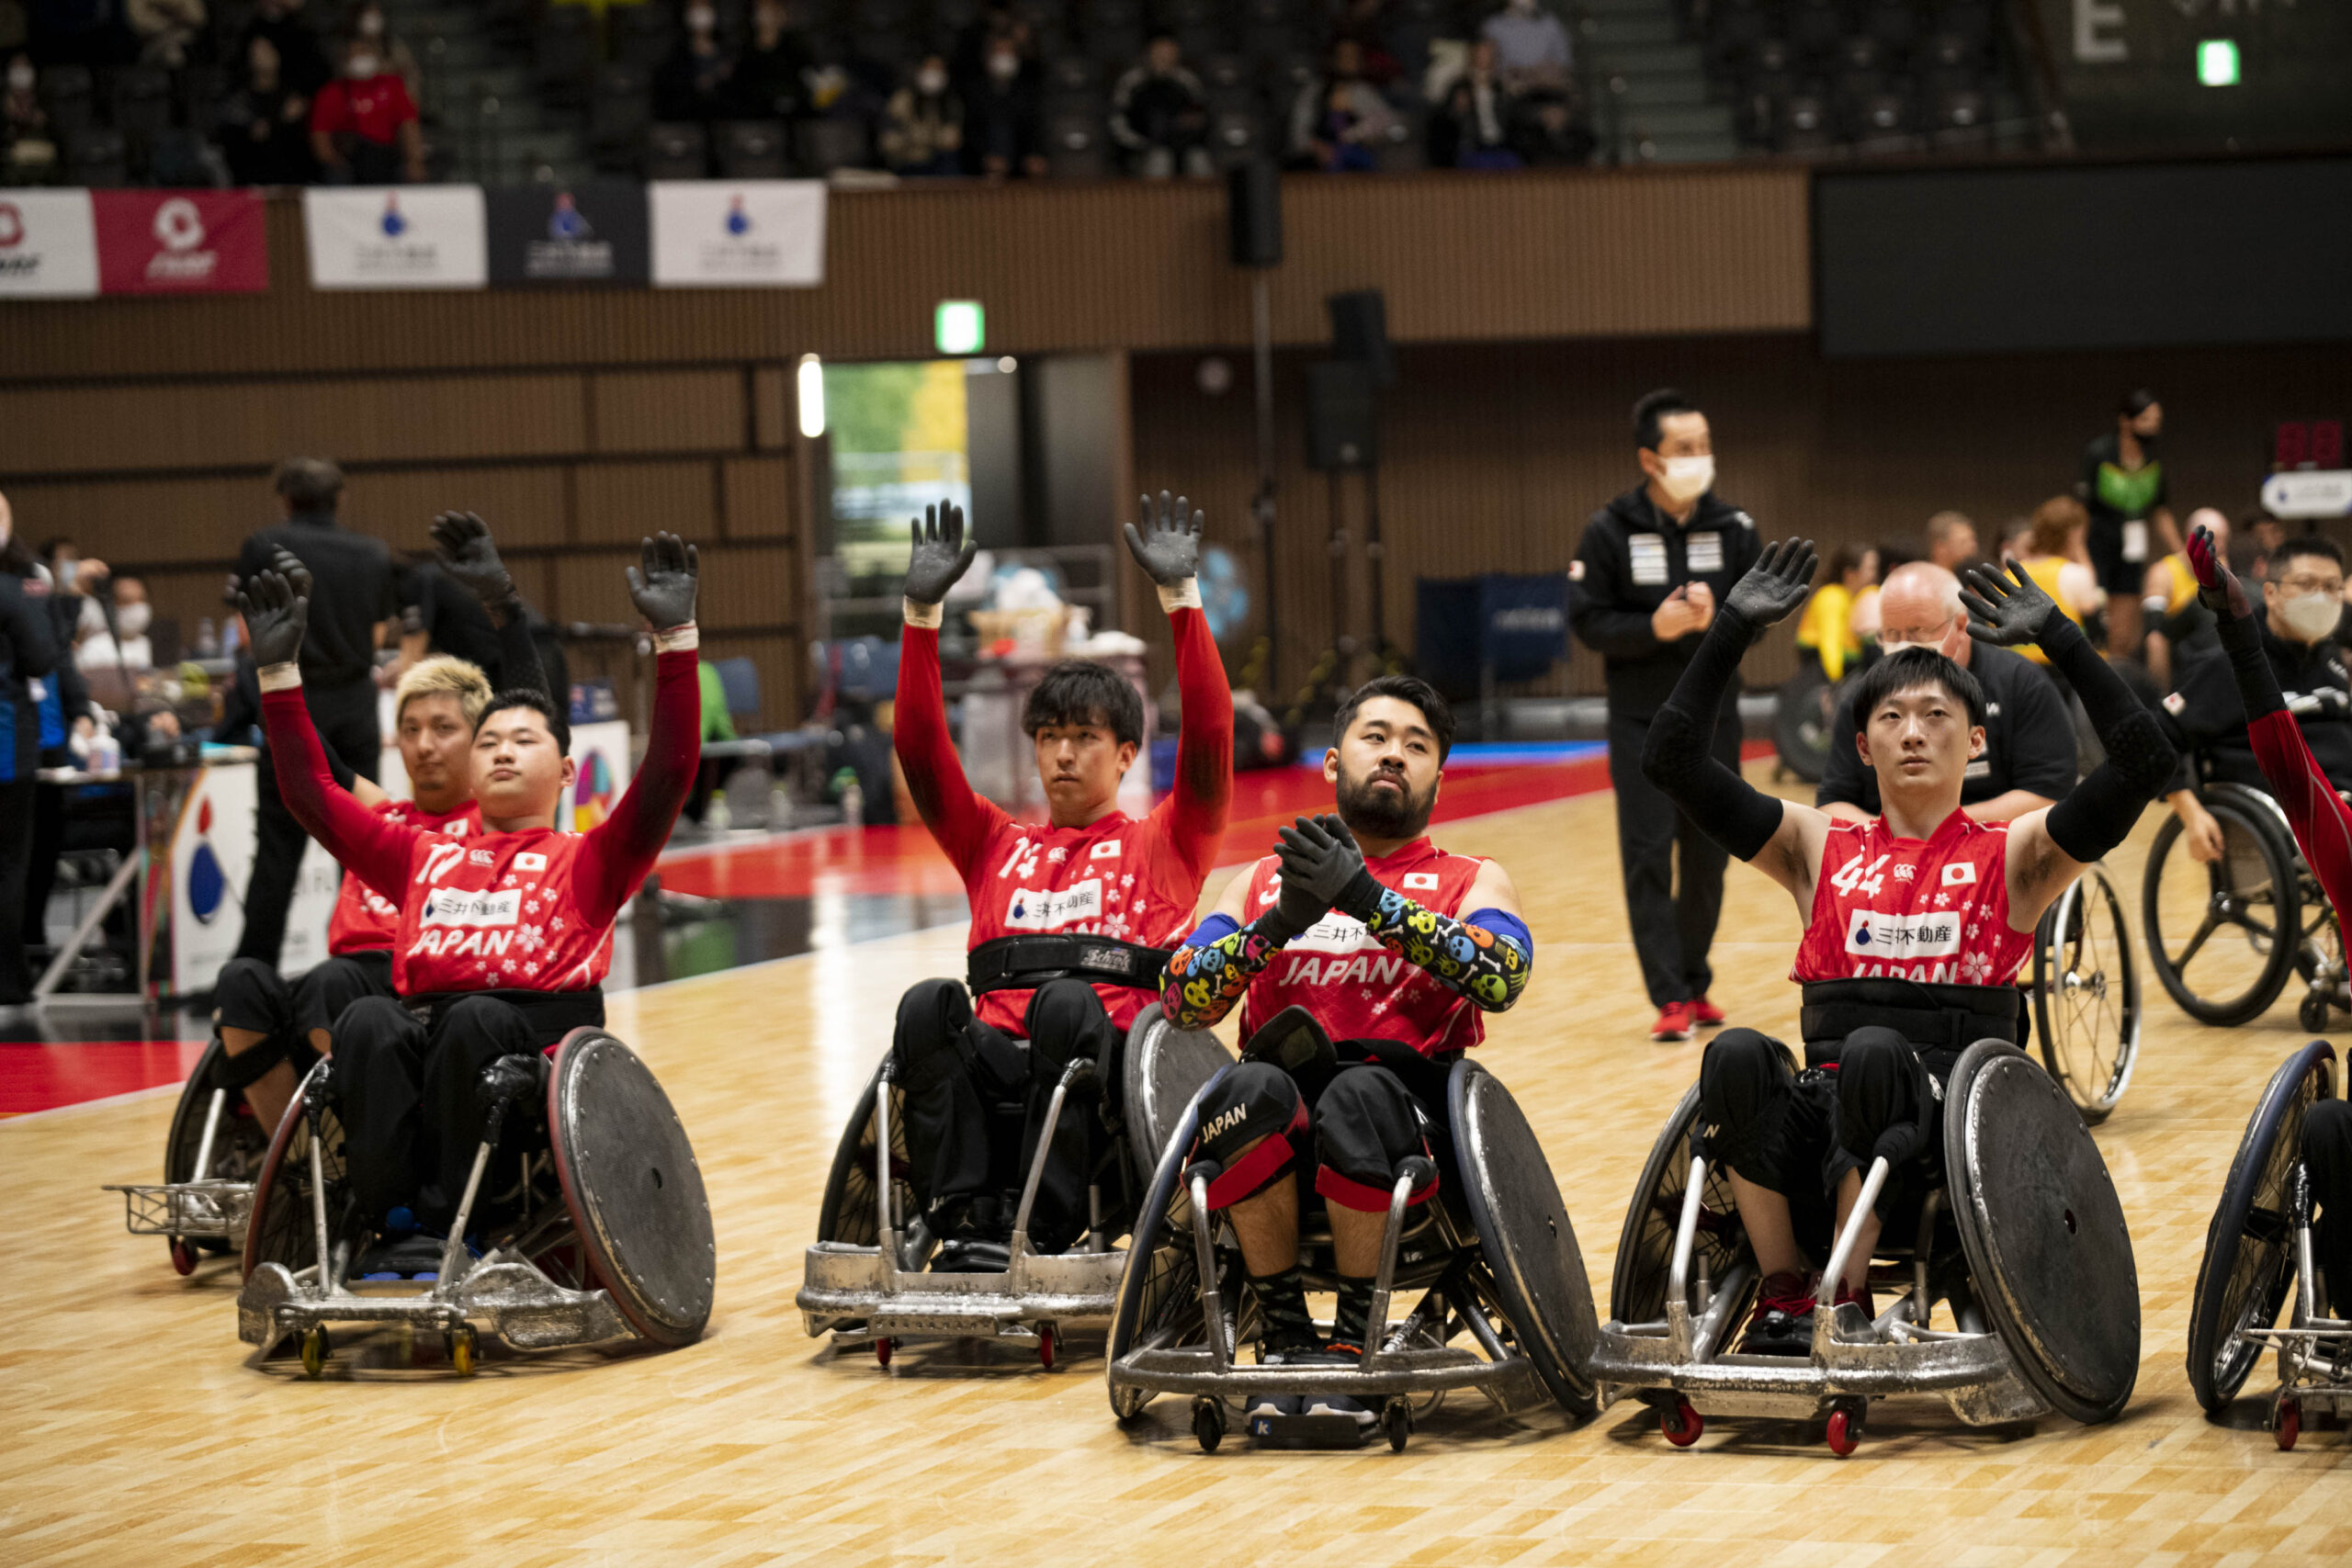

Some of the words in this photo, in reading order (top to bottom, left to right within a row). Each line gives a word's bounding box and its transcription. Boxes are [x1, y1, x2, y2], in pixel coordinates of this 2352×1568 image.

[1830, 844, 1891, 899] 44
[407, 929, 514, 955] JAPAN
[1313, 923, 1363, 942] 三井不
[1279, 955, 1404, 987] JAPAN
[1203, 1102, 1247, 1144] JAPAN
